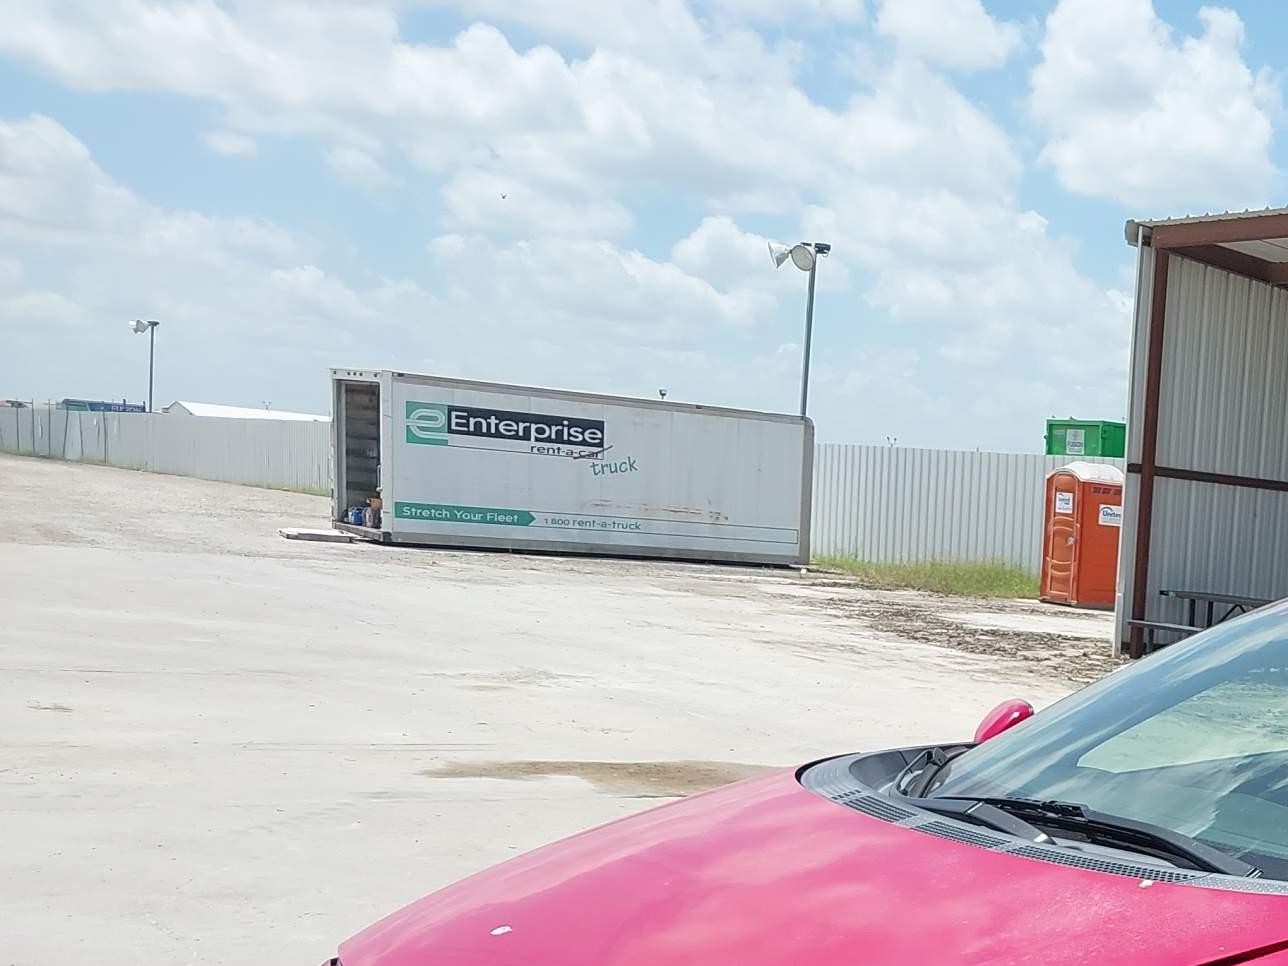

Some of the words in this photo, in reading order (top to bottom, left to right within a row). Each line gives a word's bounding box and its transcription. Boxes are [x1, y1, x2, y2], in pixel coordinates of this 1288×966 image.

[451, 411, 603, 443] Enterprise
[590, 456, 638, 475] truck
[402, 506, 450, 519] Stretch
[454, 510, 483, 521] Your
[487, 512, 519, 523] Fleet
[550, 518, 570, 527] 800
[572, 518, 641, 531] rent-a-truck
